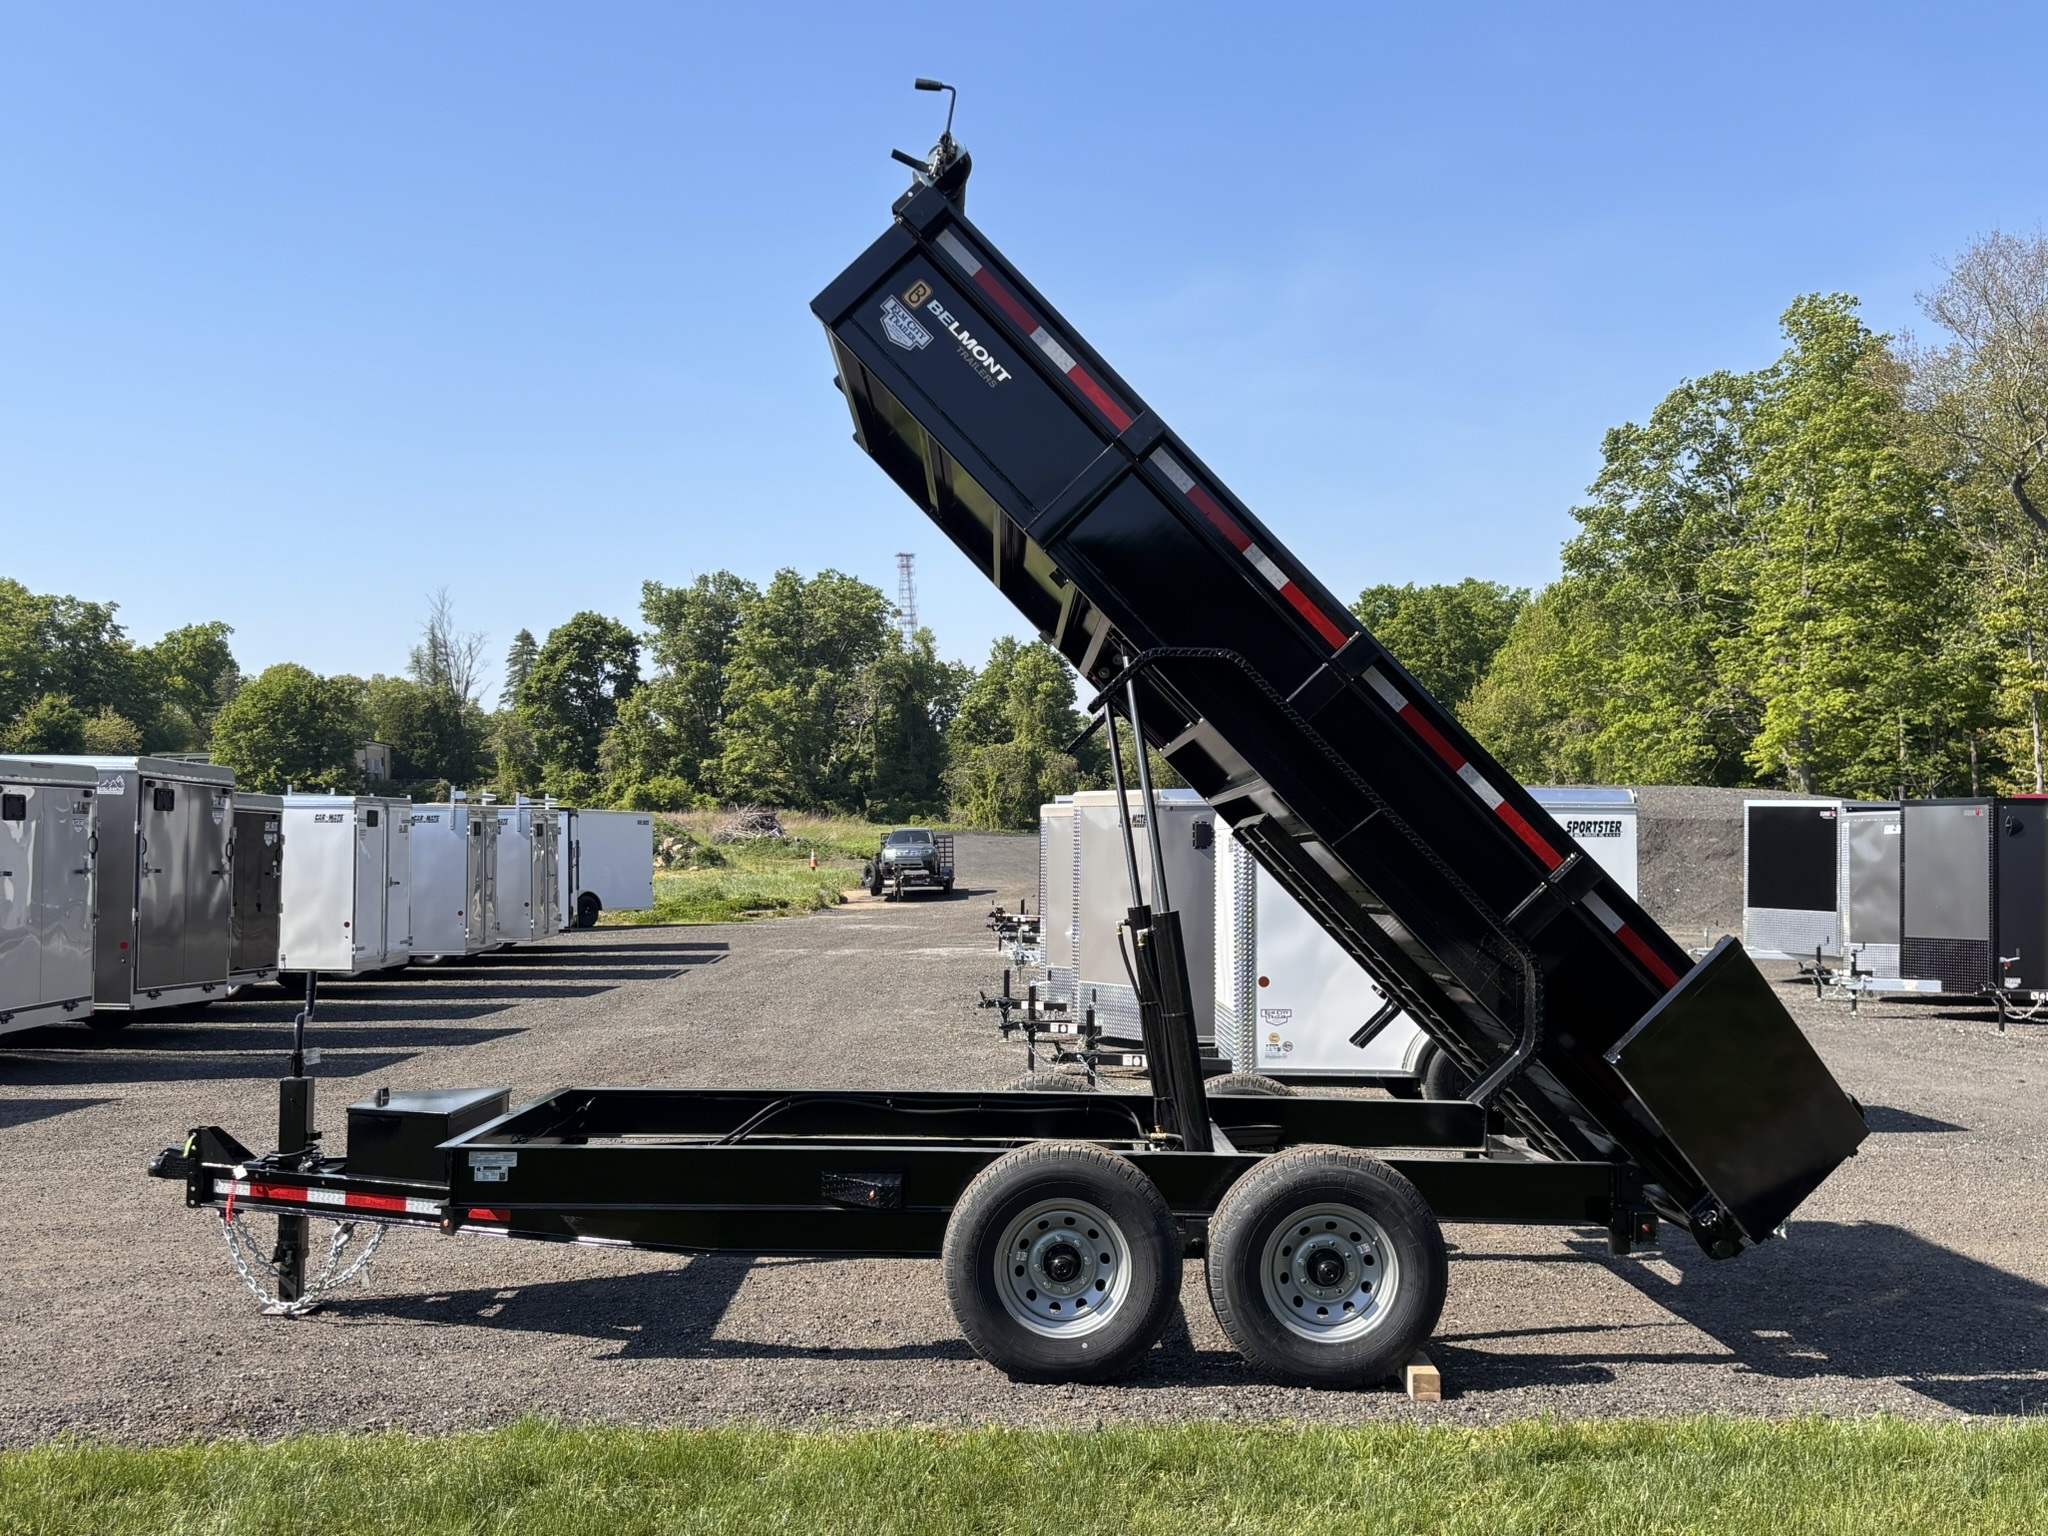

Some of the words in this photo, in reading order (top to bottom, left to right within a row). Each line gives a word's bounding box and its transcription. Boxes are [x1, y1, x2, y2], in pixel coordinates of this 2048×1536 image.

[888, 311, 916, 341] TRAILER
[890, 304, 908, 321] ELM
[906, 320, 926, 339] CITY
[926, 299, 1012, 381] BELMONT
[956, 345, 998, 388] TRAILERS
[1566, 821, 1622, 833] SPORTSTER
